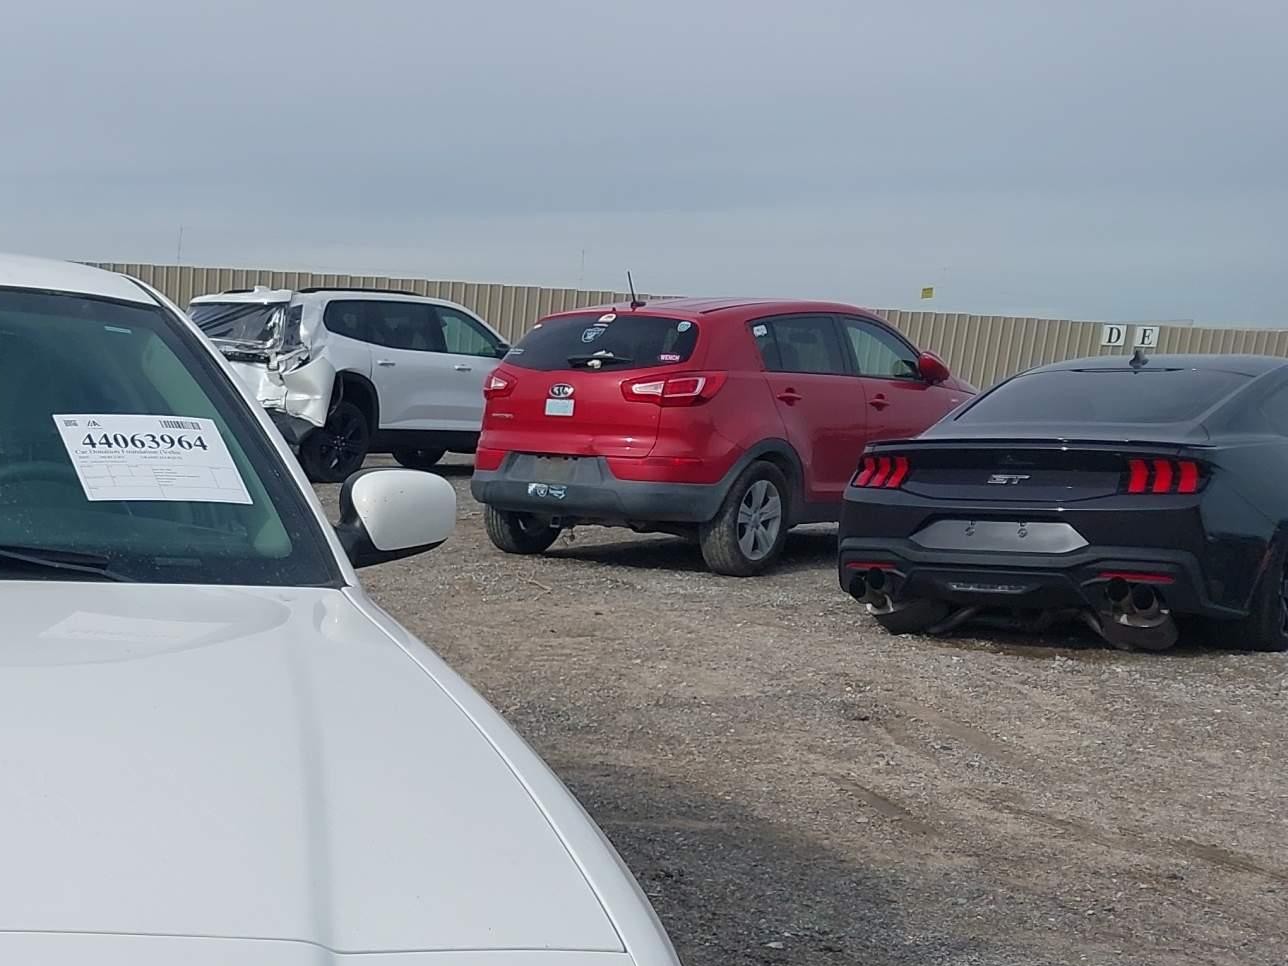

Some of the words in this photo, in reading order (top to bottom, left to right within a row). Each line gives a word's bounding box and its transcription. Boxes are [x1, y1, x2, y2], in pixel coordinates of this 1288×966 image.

[1107, 326, 1121, 344] D
[1140, 328, 1153, 345] E
[82, 433, 208, 450] 44063964
[987, 474, 1031, 484] GT
